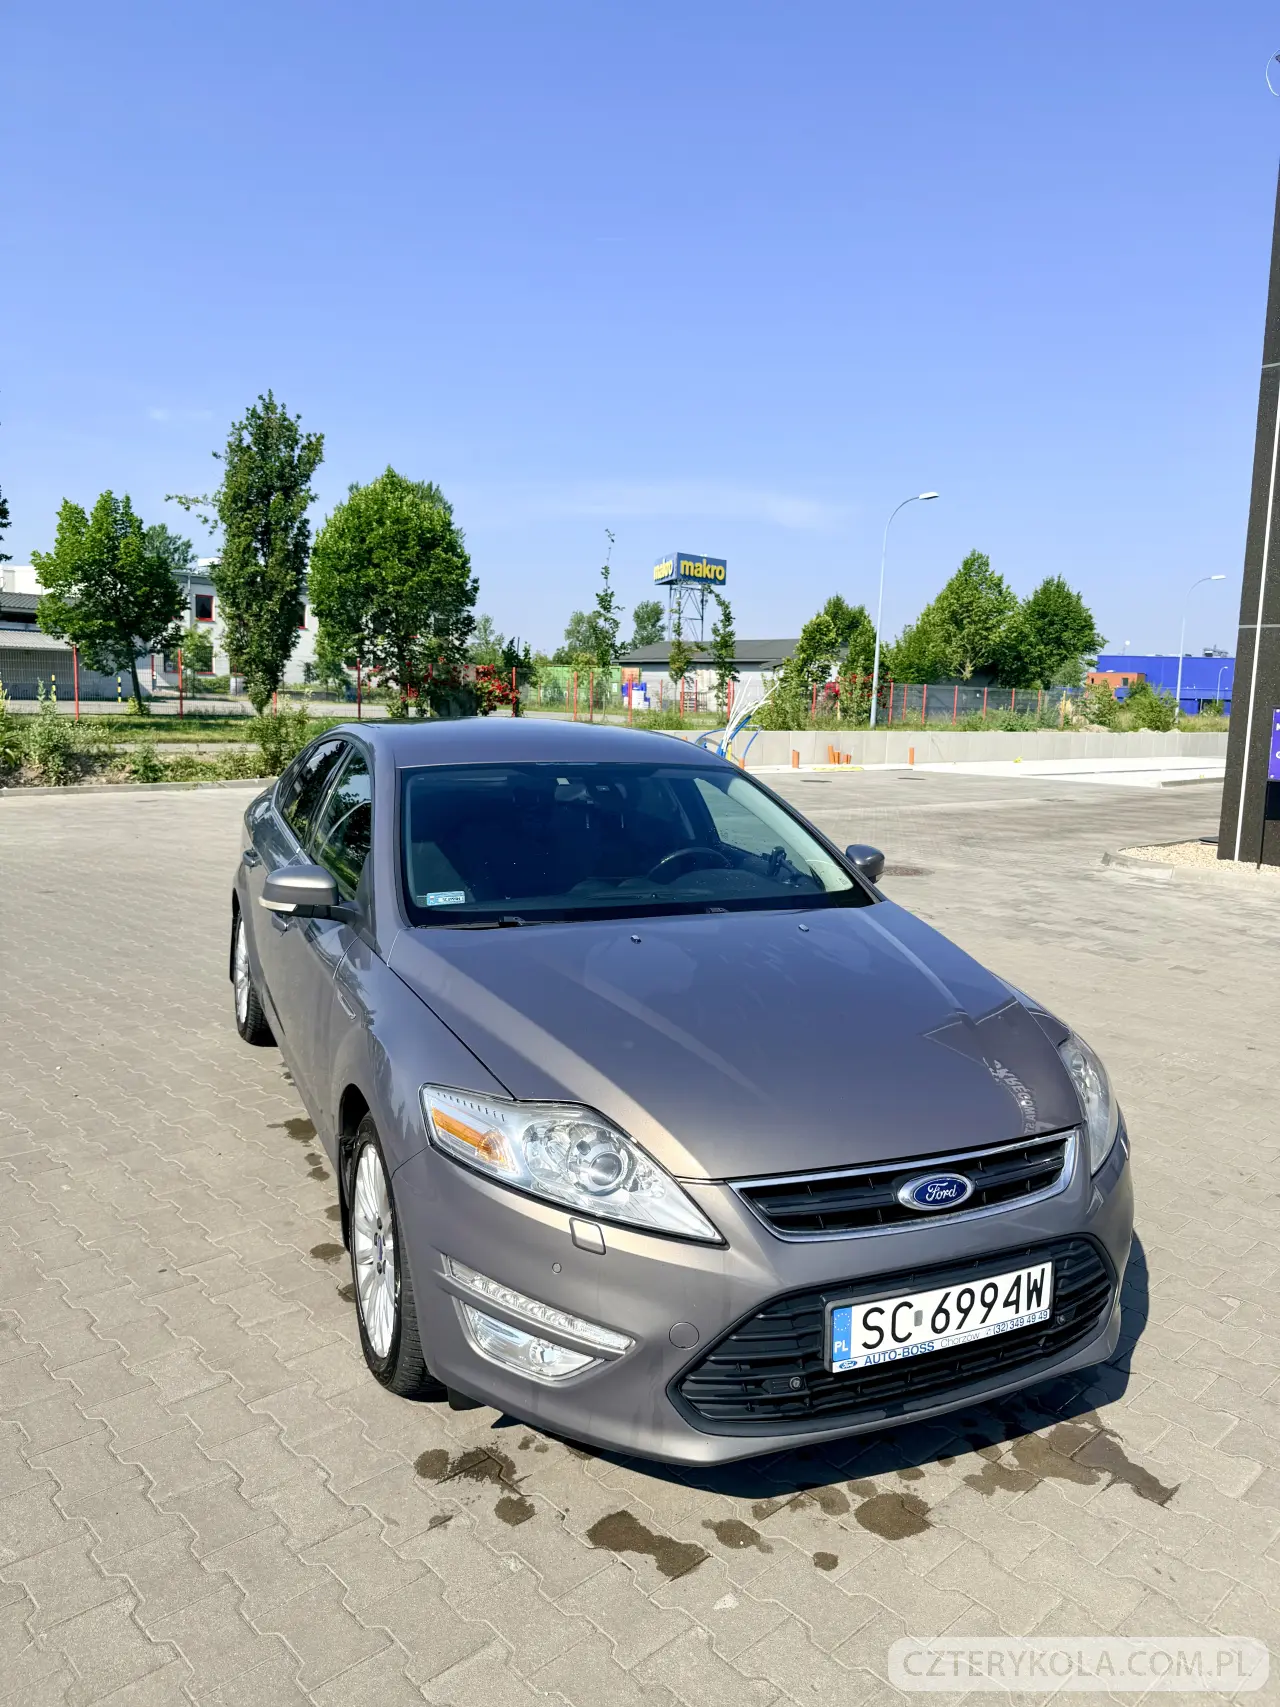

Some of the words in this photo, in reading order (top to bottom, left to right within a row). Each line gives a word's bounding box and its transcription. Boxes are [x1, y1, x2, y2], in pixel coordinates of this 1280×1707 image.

[680, 558, 725, 581] makro
[926, 1182, 957, 1202] Ford
[862, 1301, 914, 1350] SC
[931, 1268, 1045, 1334] 6994W
[834, 1340, 849, 1353] PL
[864, 1341, 935, 1365] AUTO-BOSS
[993, 1323, 1008, 1335] (32)
[1009, 1318, 1025, 1330] 349
[1026, 1314, 1037, 1324] 49
[1038, 1310, 1048, 1320] 49
